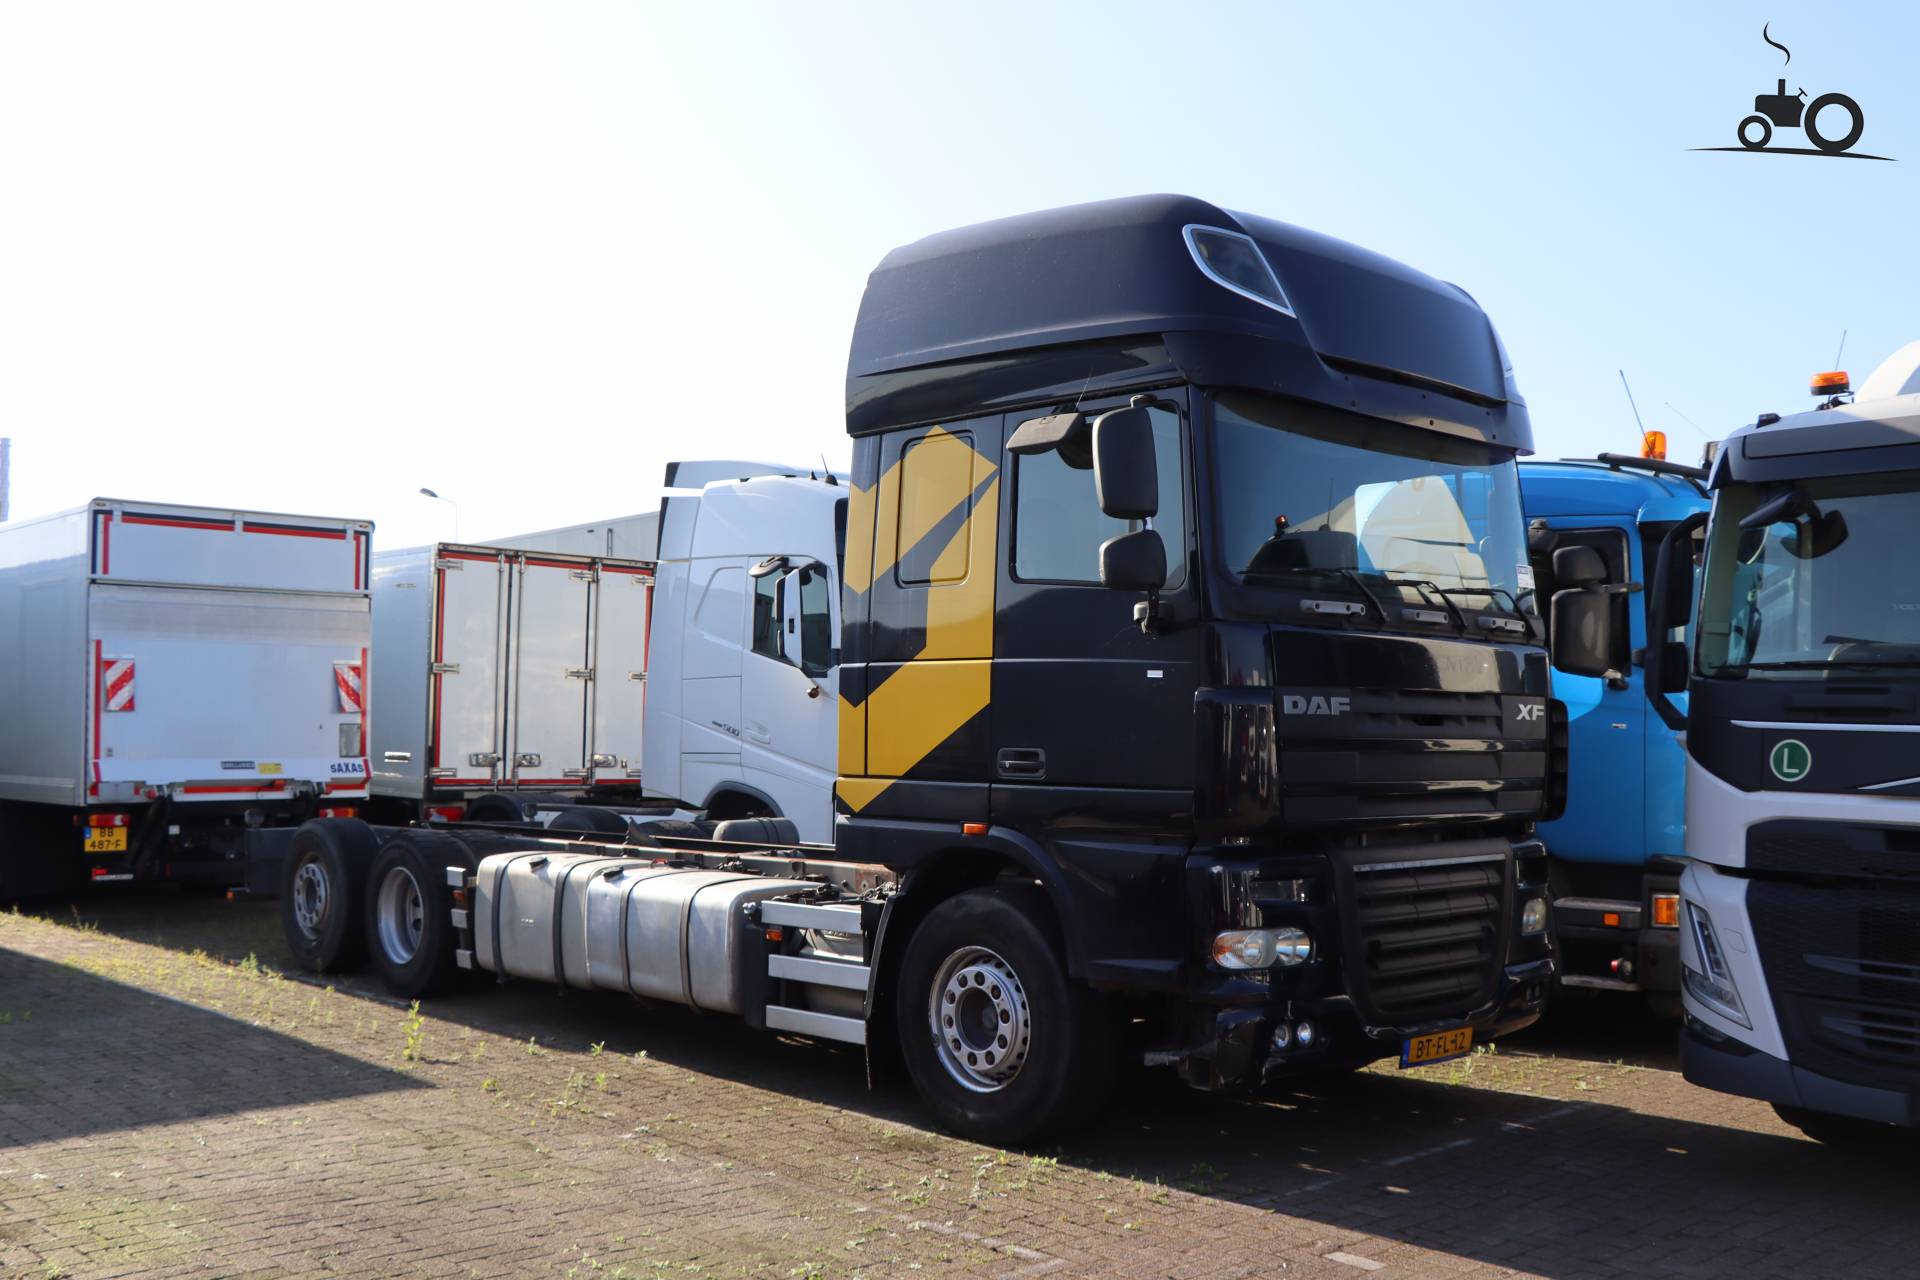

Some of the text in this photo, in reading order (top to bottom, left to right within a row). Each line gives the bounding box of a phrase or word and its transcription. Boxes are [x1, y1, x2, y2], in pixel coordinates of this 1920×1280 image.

[1283, 695, 1351, 716] DAF
[1516, 703, 1545, 721] XF
[1783, 747, 1800, 774] L
[99, 825, 114, 838] BB
[1415, 1031, 1466, 1059] BT-FL-12
